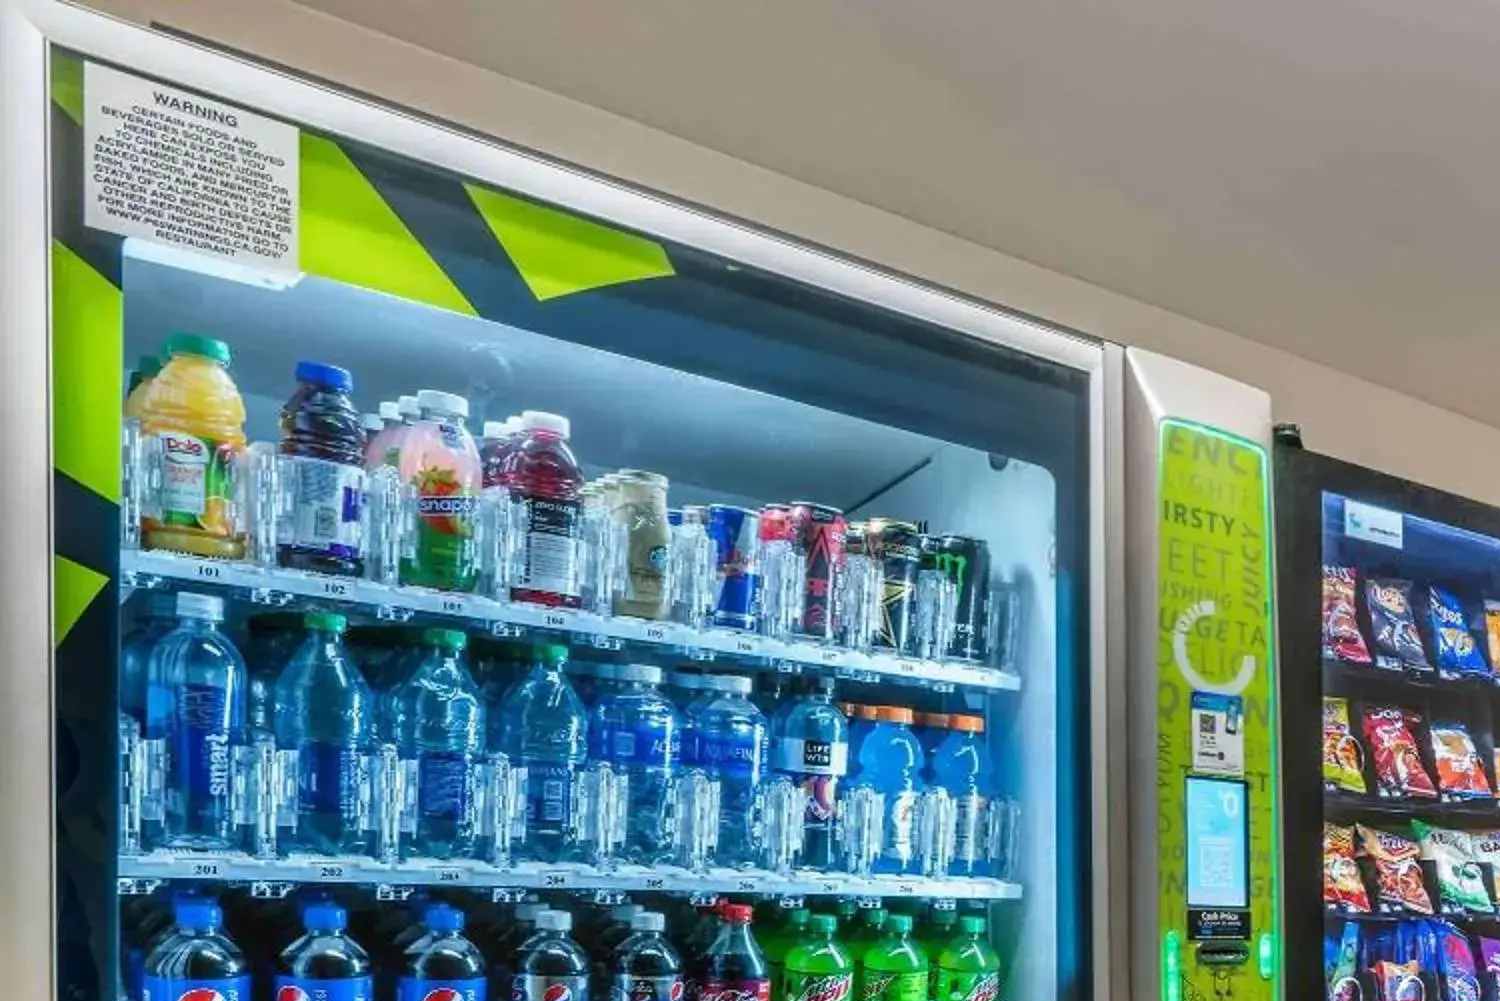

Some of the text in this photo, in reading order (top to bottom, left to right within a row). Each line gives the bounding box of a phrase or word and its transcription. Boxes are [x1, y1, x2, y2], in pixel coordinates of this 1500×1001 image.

[153, 90, 238, 128] WARNING
[166, 437, 202, 453] Dole
[1163, 500, 1234, 536] IRSTY
[198, 565, 219, 578] 101
[324, 583, 345, 595] 102
[206, 733, 229, 796] smart
[194, 864, 218, 876] 201
[320, 866, 343, 878] 202
